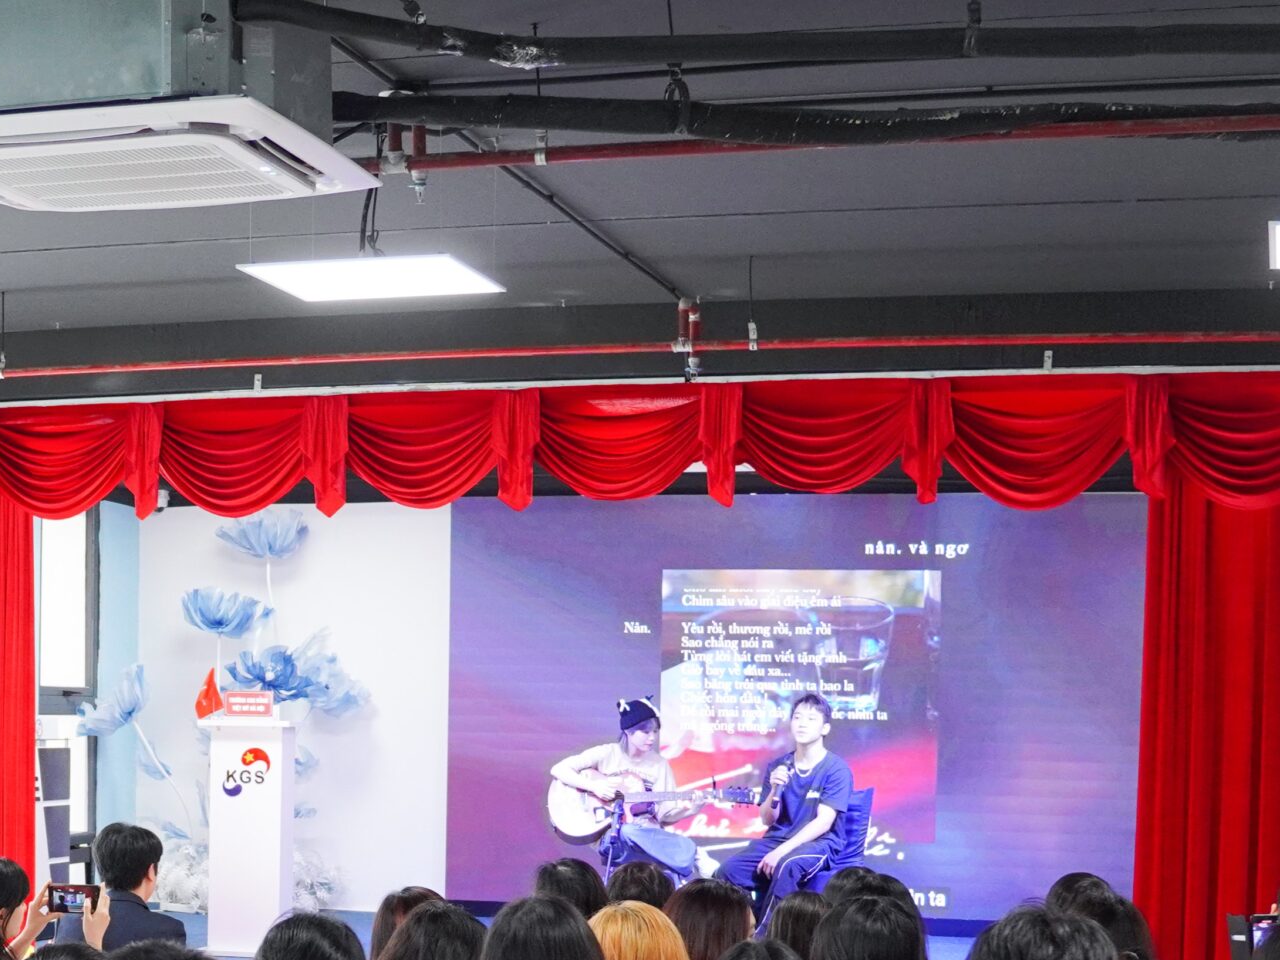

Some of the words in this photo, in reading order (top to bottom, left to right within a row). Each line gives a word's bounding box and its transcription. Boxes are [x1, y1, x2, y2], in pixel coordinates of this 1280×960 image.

[908, 540, 928, 555] và
[935, 543, 969, 559] ngơ
[681, 621, 704, 634] Yêu
[707, 620, 726, 635] rồi,
[728, 623, 771, 637] thương
[773, 620, 793, 637] rồi,
[795, 623, 813, 635] mê
[815, 620, 832, 635] rồi
[681, 636, 703, 648] Sao
[741, 637, 759, 649] nói
[761, 640, 774, 649] ra
[754, 653, 772, 663] em
[774, 649, 795, 663] viết
[806, 680, 817, 691] ta
[819, 679, 841, 691] bao
[843, 679, 854, 691] la
[876, 711, 888, 720] ta
[226, 769, 265, 784] KGS
[928, 890, 946, 907] ta
